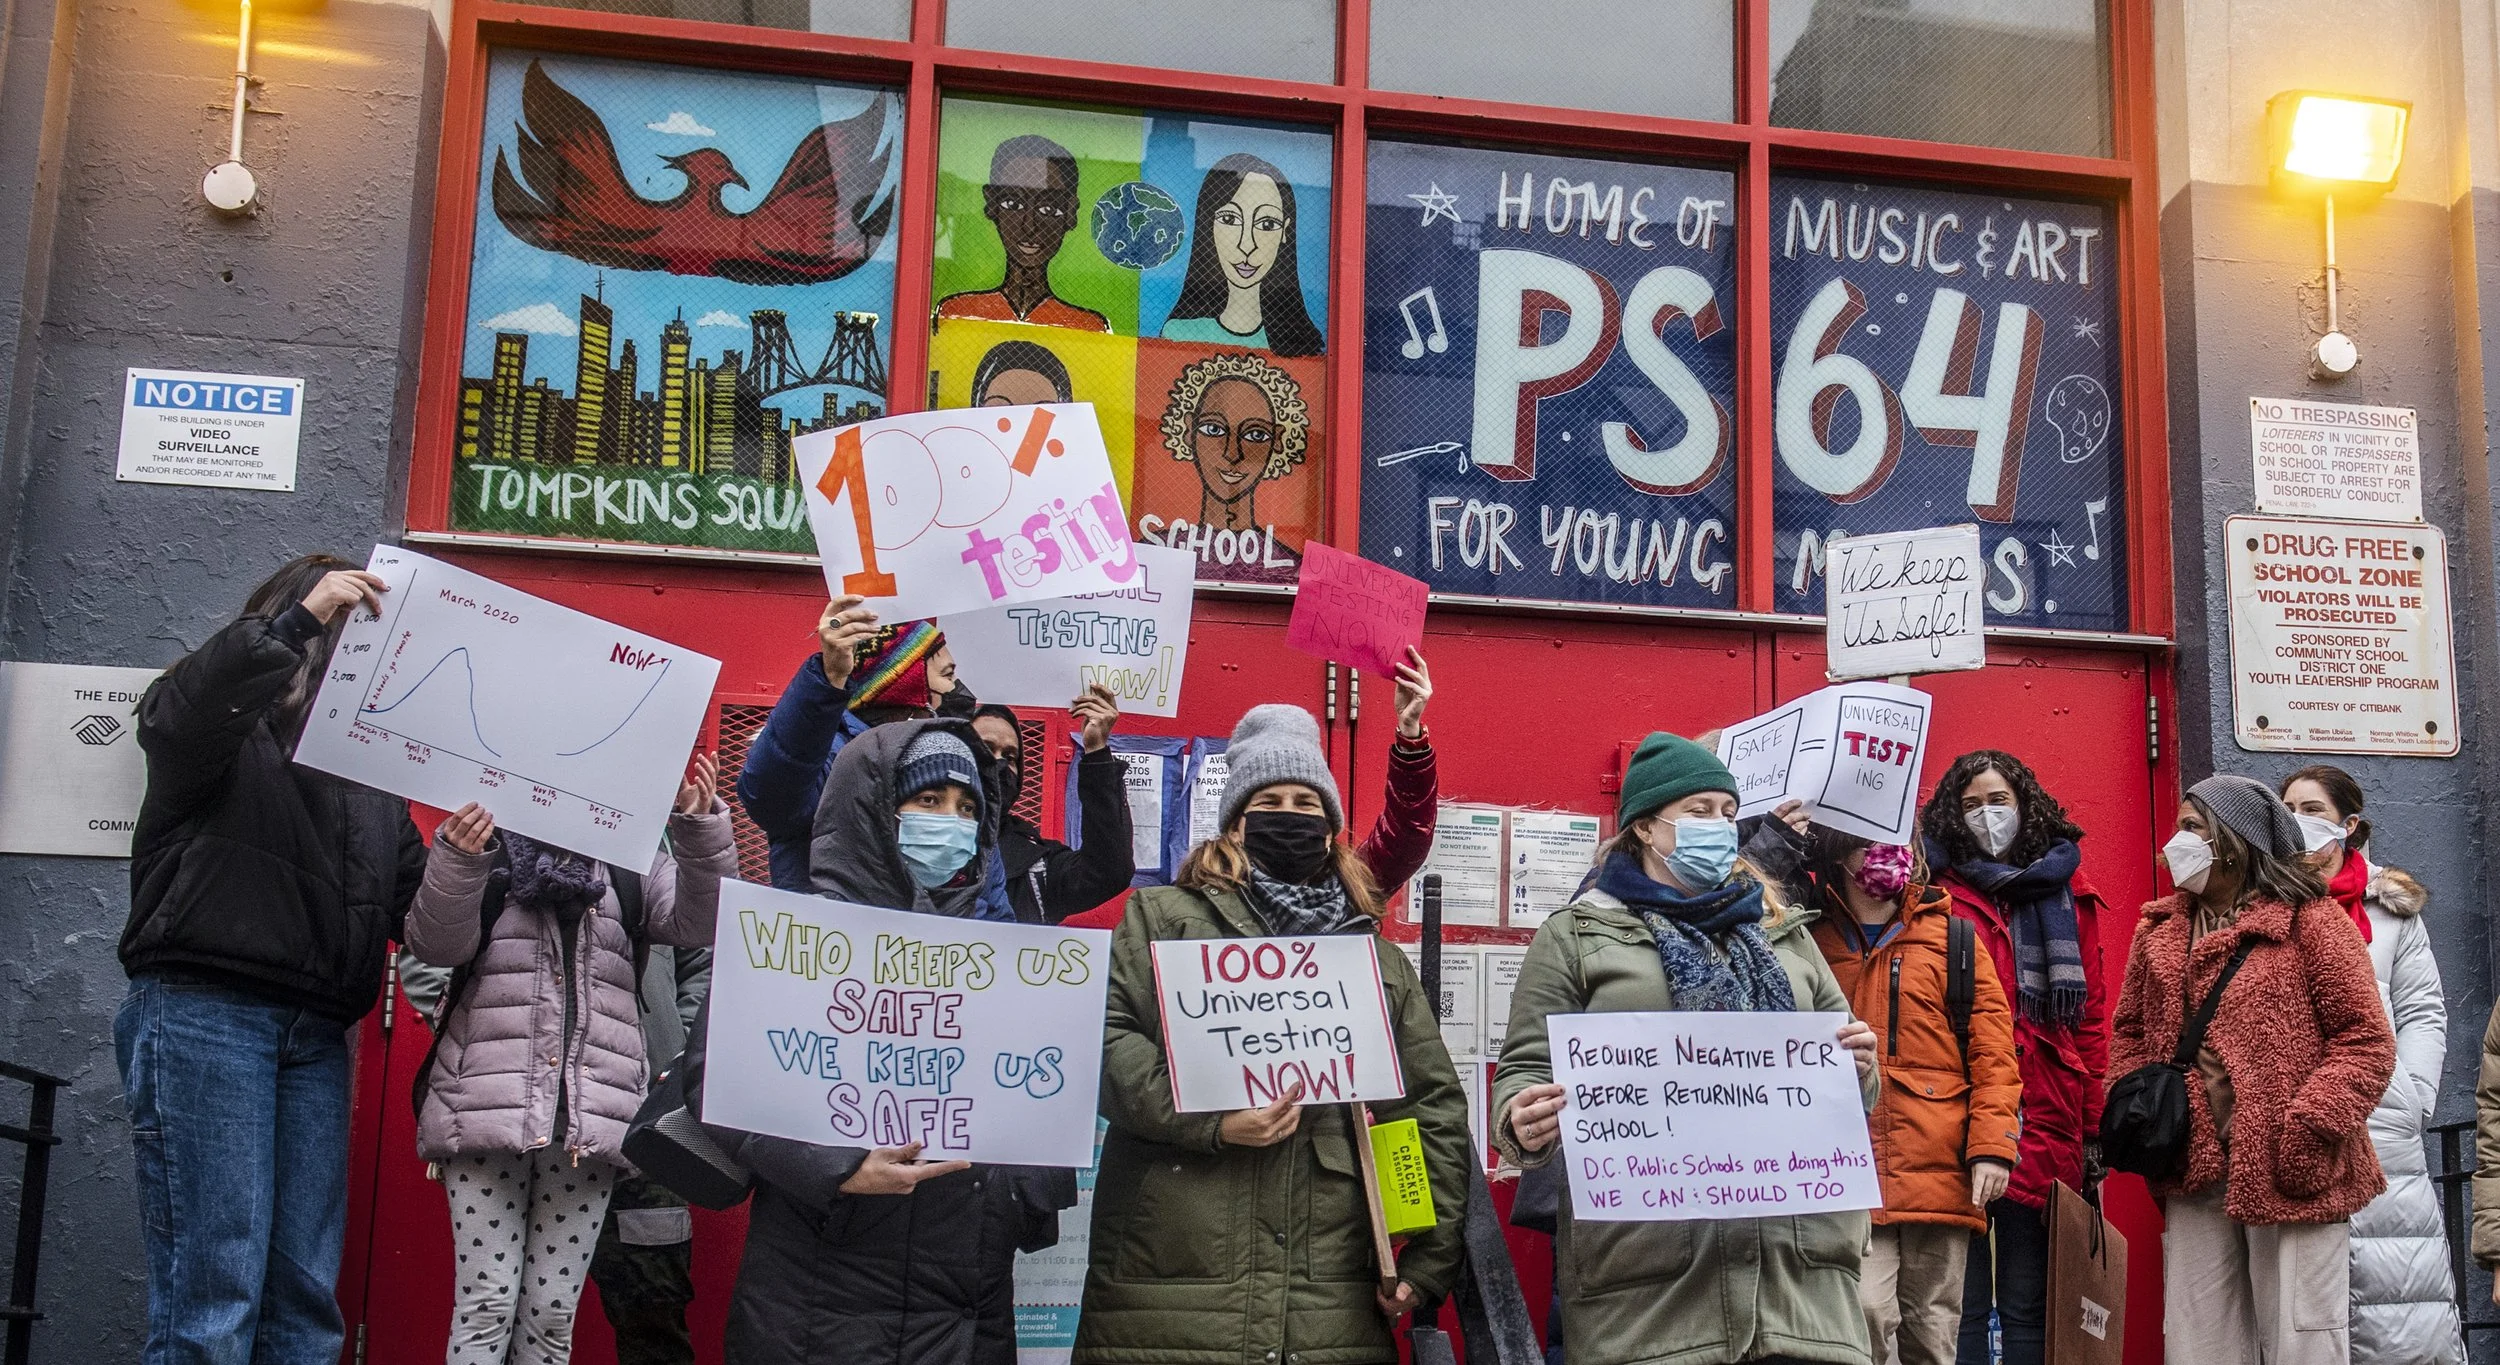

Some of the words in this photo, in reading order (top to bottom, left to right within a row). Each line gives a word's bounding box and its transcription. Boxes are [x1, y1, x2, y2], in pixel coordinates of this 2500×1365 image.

[1497, 171, 1659, 250] HOME
[1676, 195, 1727, 252] OF
[1783, 197, 1965, 275] MUSIC
[2007, 221, 2100, 288] ART
[144, 381, 283, 413] NOTICE
[1471, 247, 1732, 497] PS
[1776, 276, 2045, 524] 64
[159, 414, 178, 423] THIS
[180, 415, 222, 426] BUILDING
[223, 417, 232, 426] IS
[234, 418, 265, 428] UNDER
[2258, 404, 2283, 420] NO
[2291, 406, 2411, 430] TRESPASSING
[190, 428, 231, 440] VIDEO
[2261, 427, 2324, 442] LOITERERS
[2329, 432, 2340, 443] IN
[2344, 433, 2390, 447] VICINITY
[2394, 437, 2409, 448] OF
[152, 454, 173, 463] THAT
[176, 456, 195, 464] MAY
[197, 457, 208, 465] BE
[210, 458, 263, 468] MONITORED
[158, 440, 260, 456] SURVEILLANCE
[2259, 441, 2307, 455] SCHOOL
[2311, 445, 2328, 456] OR
[2334, 446, 2412, 462] TRESPASSERS
[135, 466, 170, 475] AND/OR
[172, 468, 222, 478] RECORDED
[223, 470, 234, 478] AT
[236, 471, 253, 479] ANY
[256, 472, 277, 481] TIME
[2258, 455, 2275, 467] ON
[2280, 457, 2327, 471] SCHOOL
[2331, 460, 2389, 474] PROPERTY
[2394, 465, 2416, 477] ARE
[2265, 470, 2316, 484] SUBJECT
[2320, 473, 2335, 485] TO
[2340, 475, 2384, 488] ARREST
[2388, 478, 2411, 490] FOR
[469, 464, 701, 530] TOMPKINS
[815, 407, 1065, 598] 100%
[2273, 484, 2342, 500] DISORDERLY
[2347, 489, 2404, 504] CONDUCT.
[961, 480, 1139, 601] testing
[1138, 514, 1295, 569] SCHOOL
[1427, 497, 1524, 573] FOR
[1541, 506, 1732, 595] YOUNG
[2263, 533, 2335, 557] DRUG
[2345, 537, 2408, 561] FREE
[1841, 544, 1888, 595] We
[1888, 541, 1969, 594] keep
[2254, 562, 2352, 585] SCHOOL
[2359, 567, 2423, 588] ZONE
[1307, 551, 1425, 614] UNIVERSAL
[439, 588, 477, 610] March
[483, 604, 519, 624] 2020
[1315, 580, 1410, 626] TESTING
[2257, 589, 2350, 606] VIOLATORS
[2355, 594, 2395, 608] WILL
[2399, 595, 2422, 609] BE
[354, 612, 381, 624] 6,000
[1841, 599, 1889, 648] Us
[2284, 607, 2397, 625] PROSECUTED
[1007, 608, 1158, 657] TESTING
[2291, 633, 2369, 648] SPONSORED
[2374, 637, 2391, 648] BY
[342, 643, 371, 655] 4,000
[2275, 646, 2351, 660] COMMUNITY
[2356, 650, 2408, 662] SCHOOL
[331, 670, 356, 682] 2,000
[373, 673, 390, 700] schools
[389, 659, 397, 675] go
[394, 630, 413, 658] remote
[1081, 645, 1173, 707] NOW!
[2300, 661, 2356, 674] DISTRICT
[2359, 664, 2386, 675] ONE
[2248, 672, 2290, 685] YOUTH
[2295, 674, 2372, 688] LEADERSHIP
[2377, 678, 2439, 690] PROGRAM
[74, 690, 102, 702] THE
[2288, 701, 2339, 712] COURTESY
[2343, 703, 2356, 712] OF
[2359, 703, 2402, 714] CITIBANK
[329, 709, 338, 719] 0
[1843, 704, 1918, 733] UNIVERSAL
[347, 730, 371, 745] 2020
[353, 721, 377, 736] March
[404, 741, 420, 756] April
[1735, 724, 1786, 761] SAFE
[1843, 731, 1914, 767] TEST
[407, 753, 426, 765] 2020
[1138, 755, 1150, 764] OF
[479, 777, 498, 788] 2020
[533, 785, 547, 795] Nov
[1196, 777, 1219, 786] PARA
[1735, 763, 1787, 794] CHOOLS
[532, 794, 552, 808] 2021
[589, 803, 605, 816] Dec
[594, 817, 617, 830] 2021
[739, 910, 851, 981] WHO
[874, 934, 995, 991] KEEPS
[1017, 938, 1090, 986] US
[1200, 941, 1319, 984] 100%
[827, 978, 963, 1039] SAFE
[1177, 980, 1350, 1019] Universal
[1207, 1018, 1353, 1058] Testing
[768, 1027, 841, 1080] WE
[868, 1041, 965, 1095] KEEP
[994, 1046, 1064, 1099] US
[1567, 1036, 1659, 1070] REQUIRE
[1675, 1034, 1776, 1068] NEGATIVE
[1785, 1038, 1839, 1069] PCR
[1242, 1053, 1358, 1107] NOW!
[1575, 1082, 1649, 1111] BEFORE
[1663, 1080, 1768, 1109] RETURNING
[1777, 1086, 1812, 1108] TO
[827, 1082, 973, 1151] SAFE
[1392, 1150, 1409, 1205] ASSORTMENT
[1400, 1145, 1421, 1206] CRACKER
[1583, 1157, 1622, 1181] D.C.
[1627, 1155, 1679, 1179] Public
[1682, 1153, 1744, 1175] Schools
[1754, 1158, 1781, 1174] are
[1787, 1151, 1830, 1179] doing
[1830, 1147, 1869, 1170] this
[1588, 1189, 1623, 1209] WE
[1642, 1187, 1685, 1209] CAN
[1706, 1184, 1787, 1206] SHOULD
[1797, 1181, 1845, 1201] TOO
